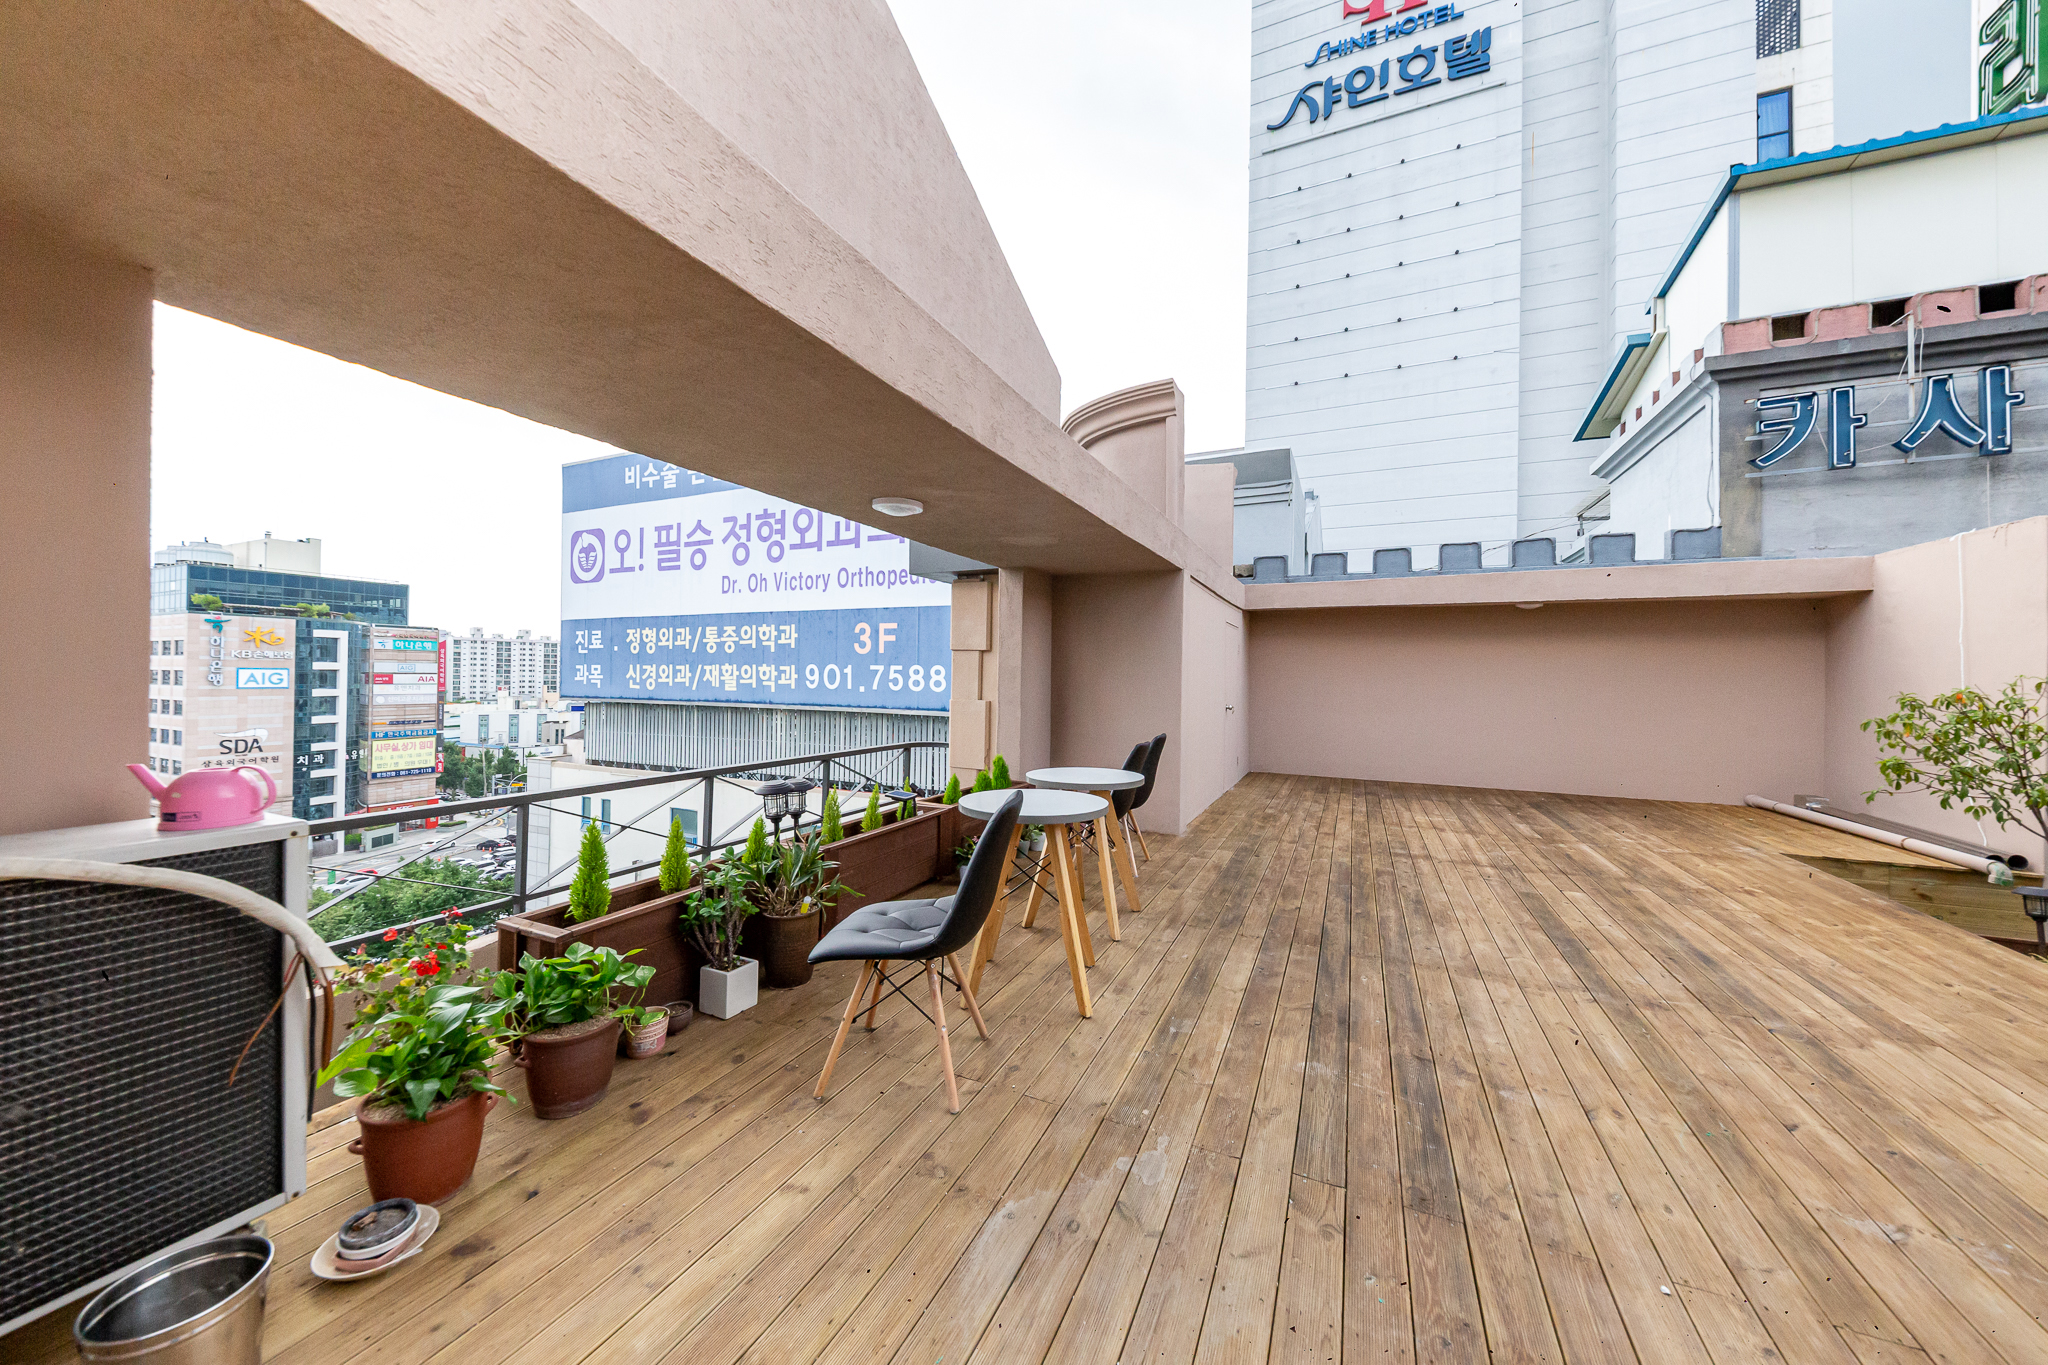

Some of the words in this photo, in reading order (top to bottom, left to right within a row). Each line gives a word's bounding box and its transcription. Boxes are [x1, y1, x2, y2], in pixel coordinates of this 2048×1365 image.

[1304, 28, 1378, 69] SHINE
[1384, 2, 1465, 41] HOTEL
[1266, 25, 1492, 131] 샤인호텔
[624, 462, 680, 490] 비수술
[721, 574, 742, 595] Dr.
[748, 572, 768, 593] Oh
[773, 570, 831, 593] Victory
[575, 629, 604, 654] 진료
[853, 621, 898, 655] 3F
[243, 672, 284, 686] AIG
[574, 663, 604, 689] 과목
[805, 663, 947, 693] 901.7588
[218, 738, 264, 755] SDA
[296, 753, 325, 766] 치과
